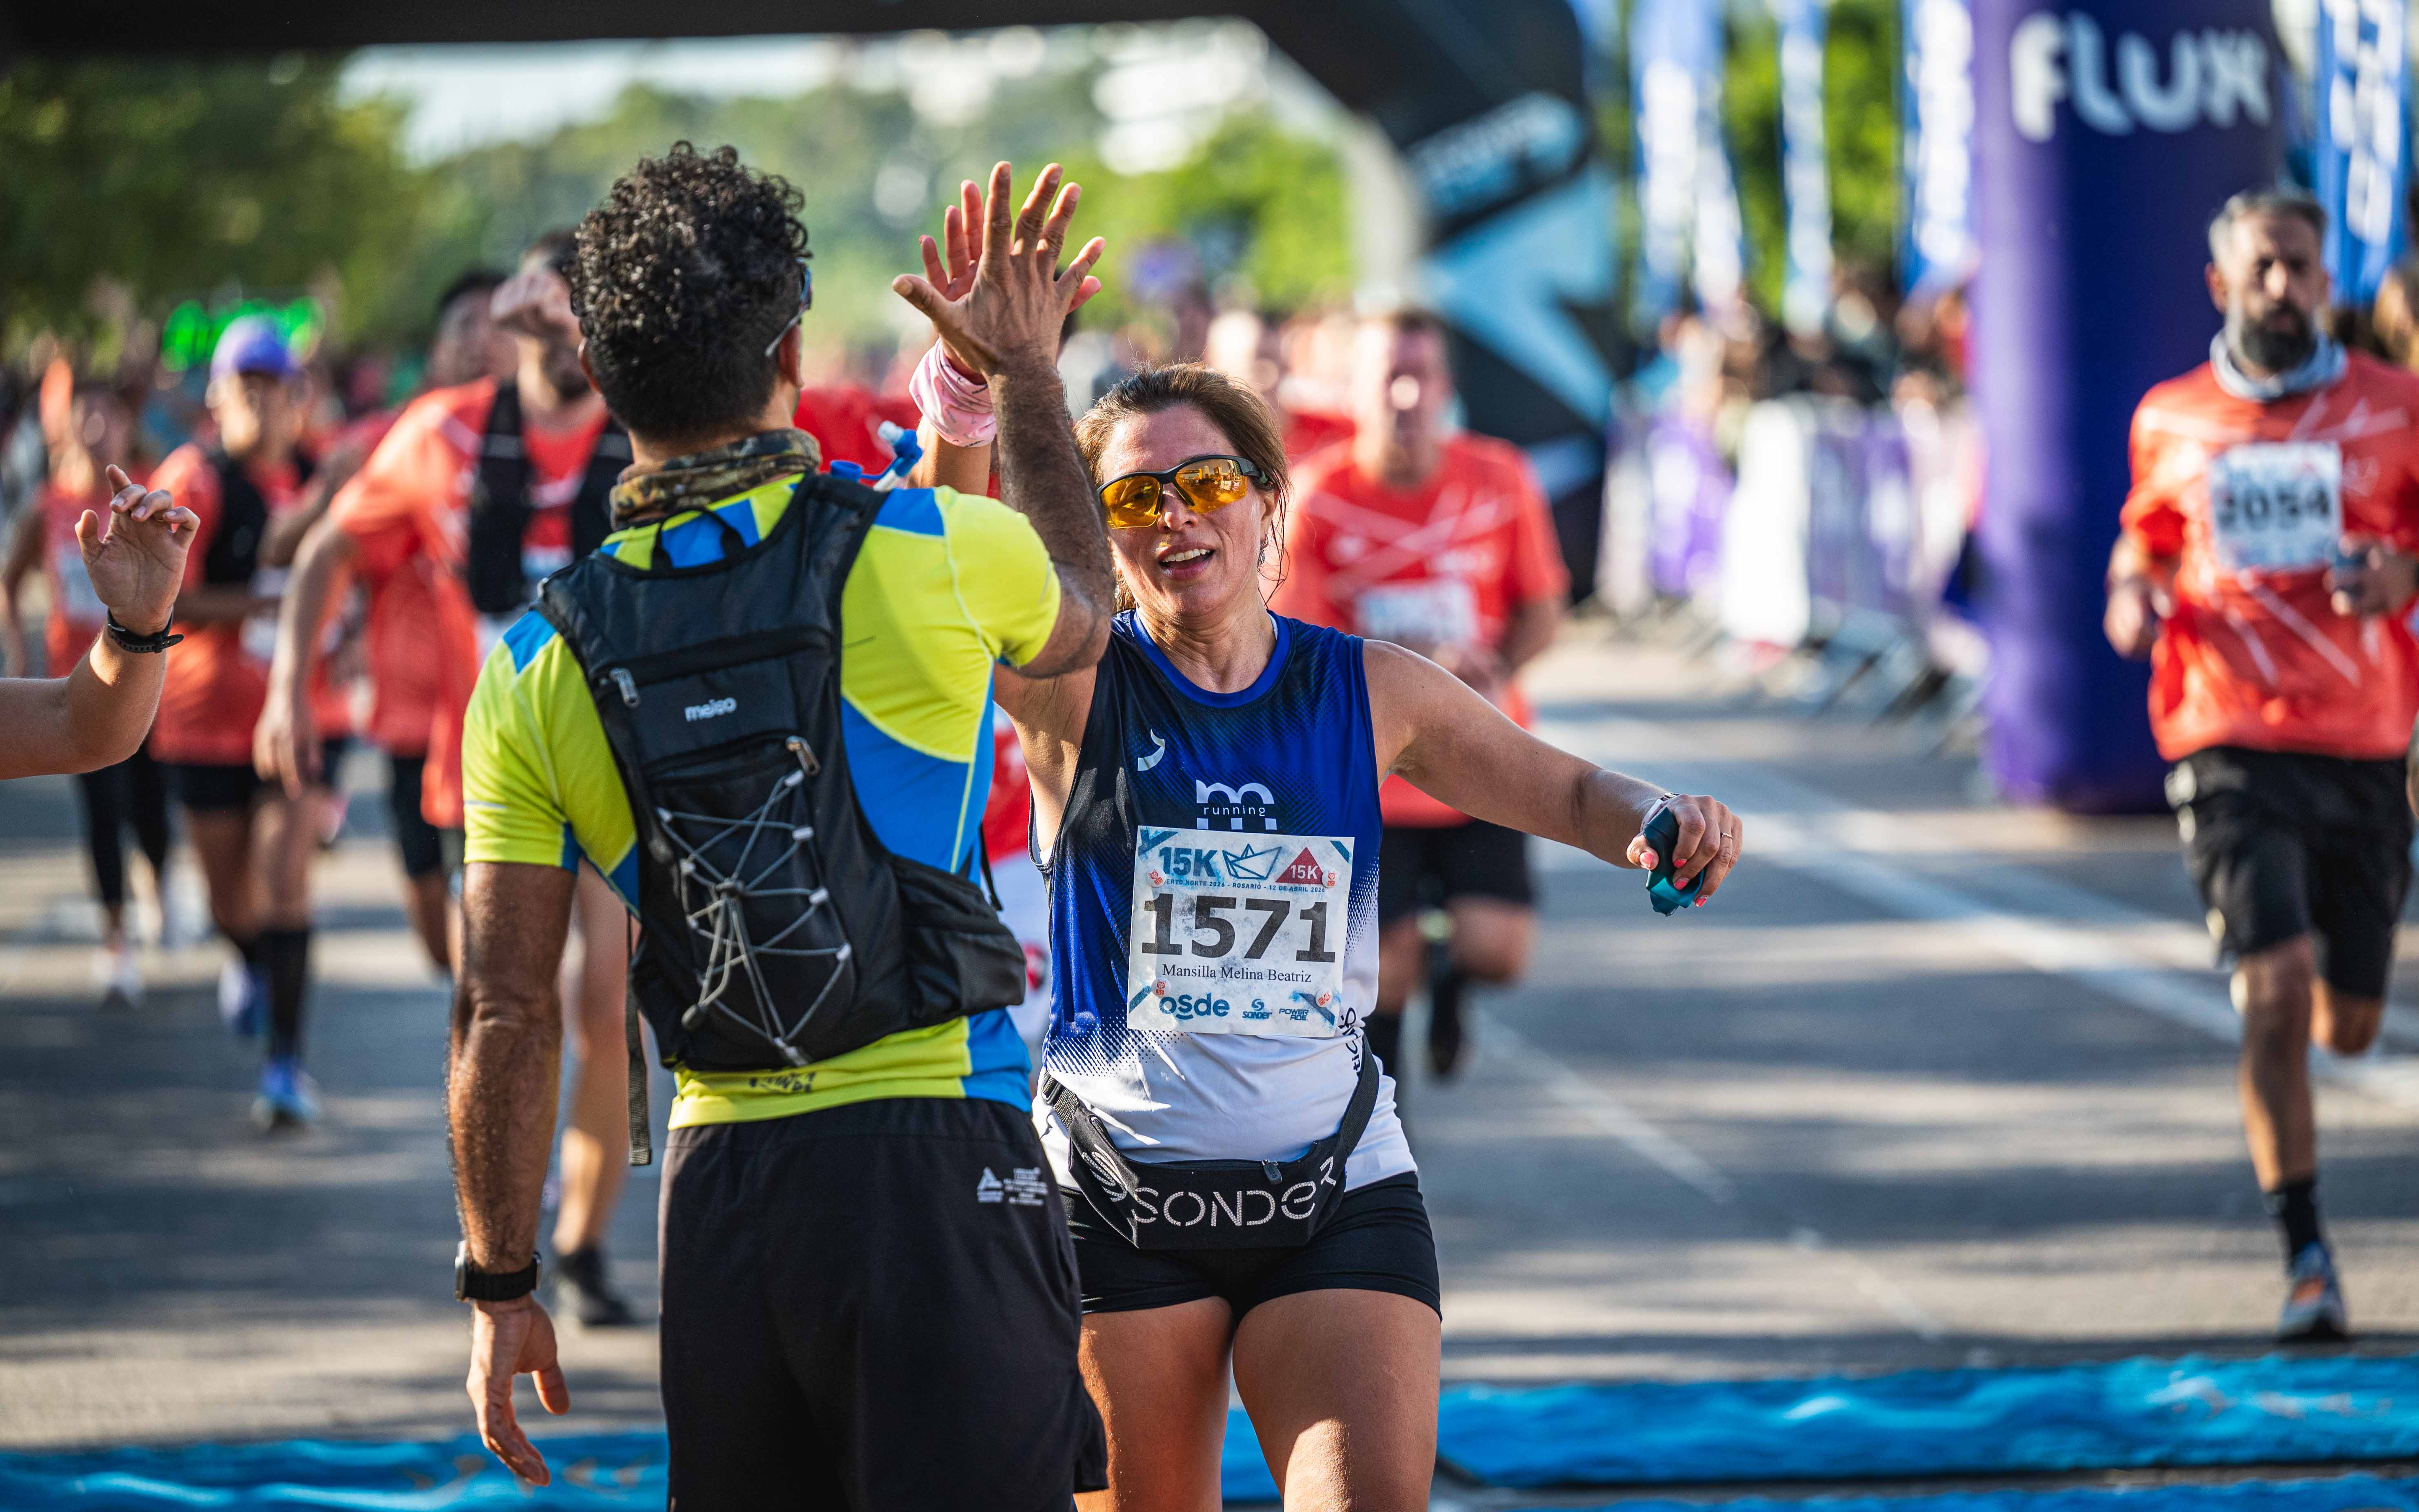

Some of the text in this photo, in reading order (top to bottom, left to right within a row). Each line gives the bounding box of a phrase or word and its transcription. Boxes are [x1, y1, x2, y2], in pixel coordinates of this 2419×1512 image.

[1204, 805, 1266, 817] running
[1159, 846, 1217, 877] 15K
[1291, 865, 1318, 880] 15K
[1142, 893, 1335, 963] 1571
[1162, 964, 1311, 982] Mansilla Melina Beatriz
[1159, 992, 1230, 1020] osde
